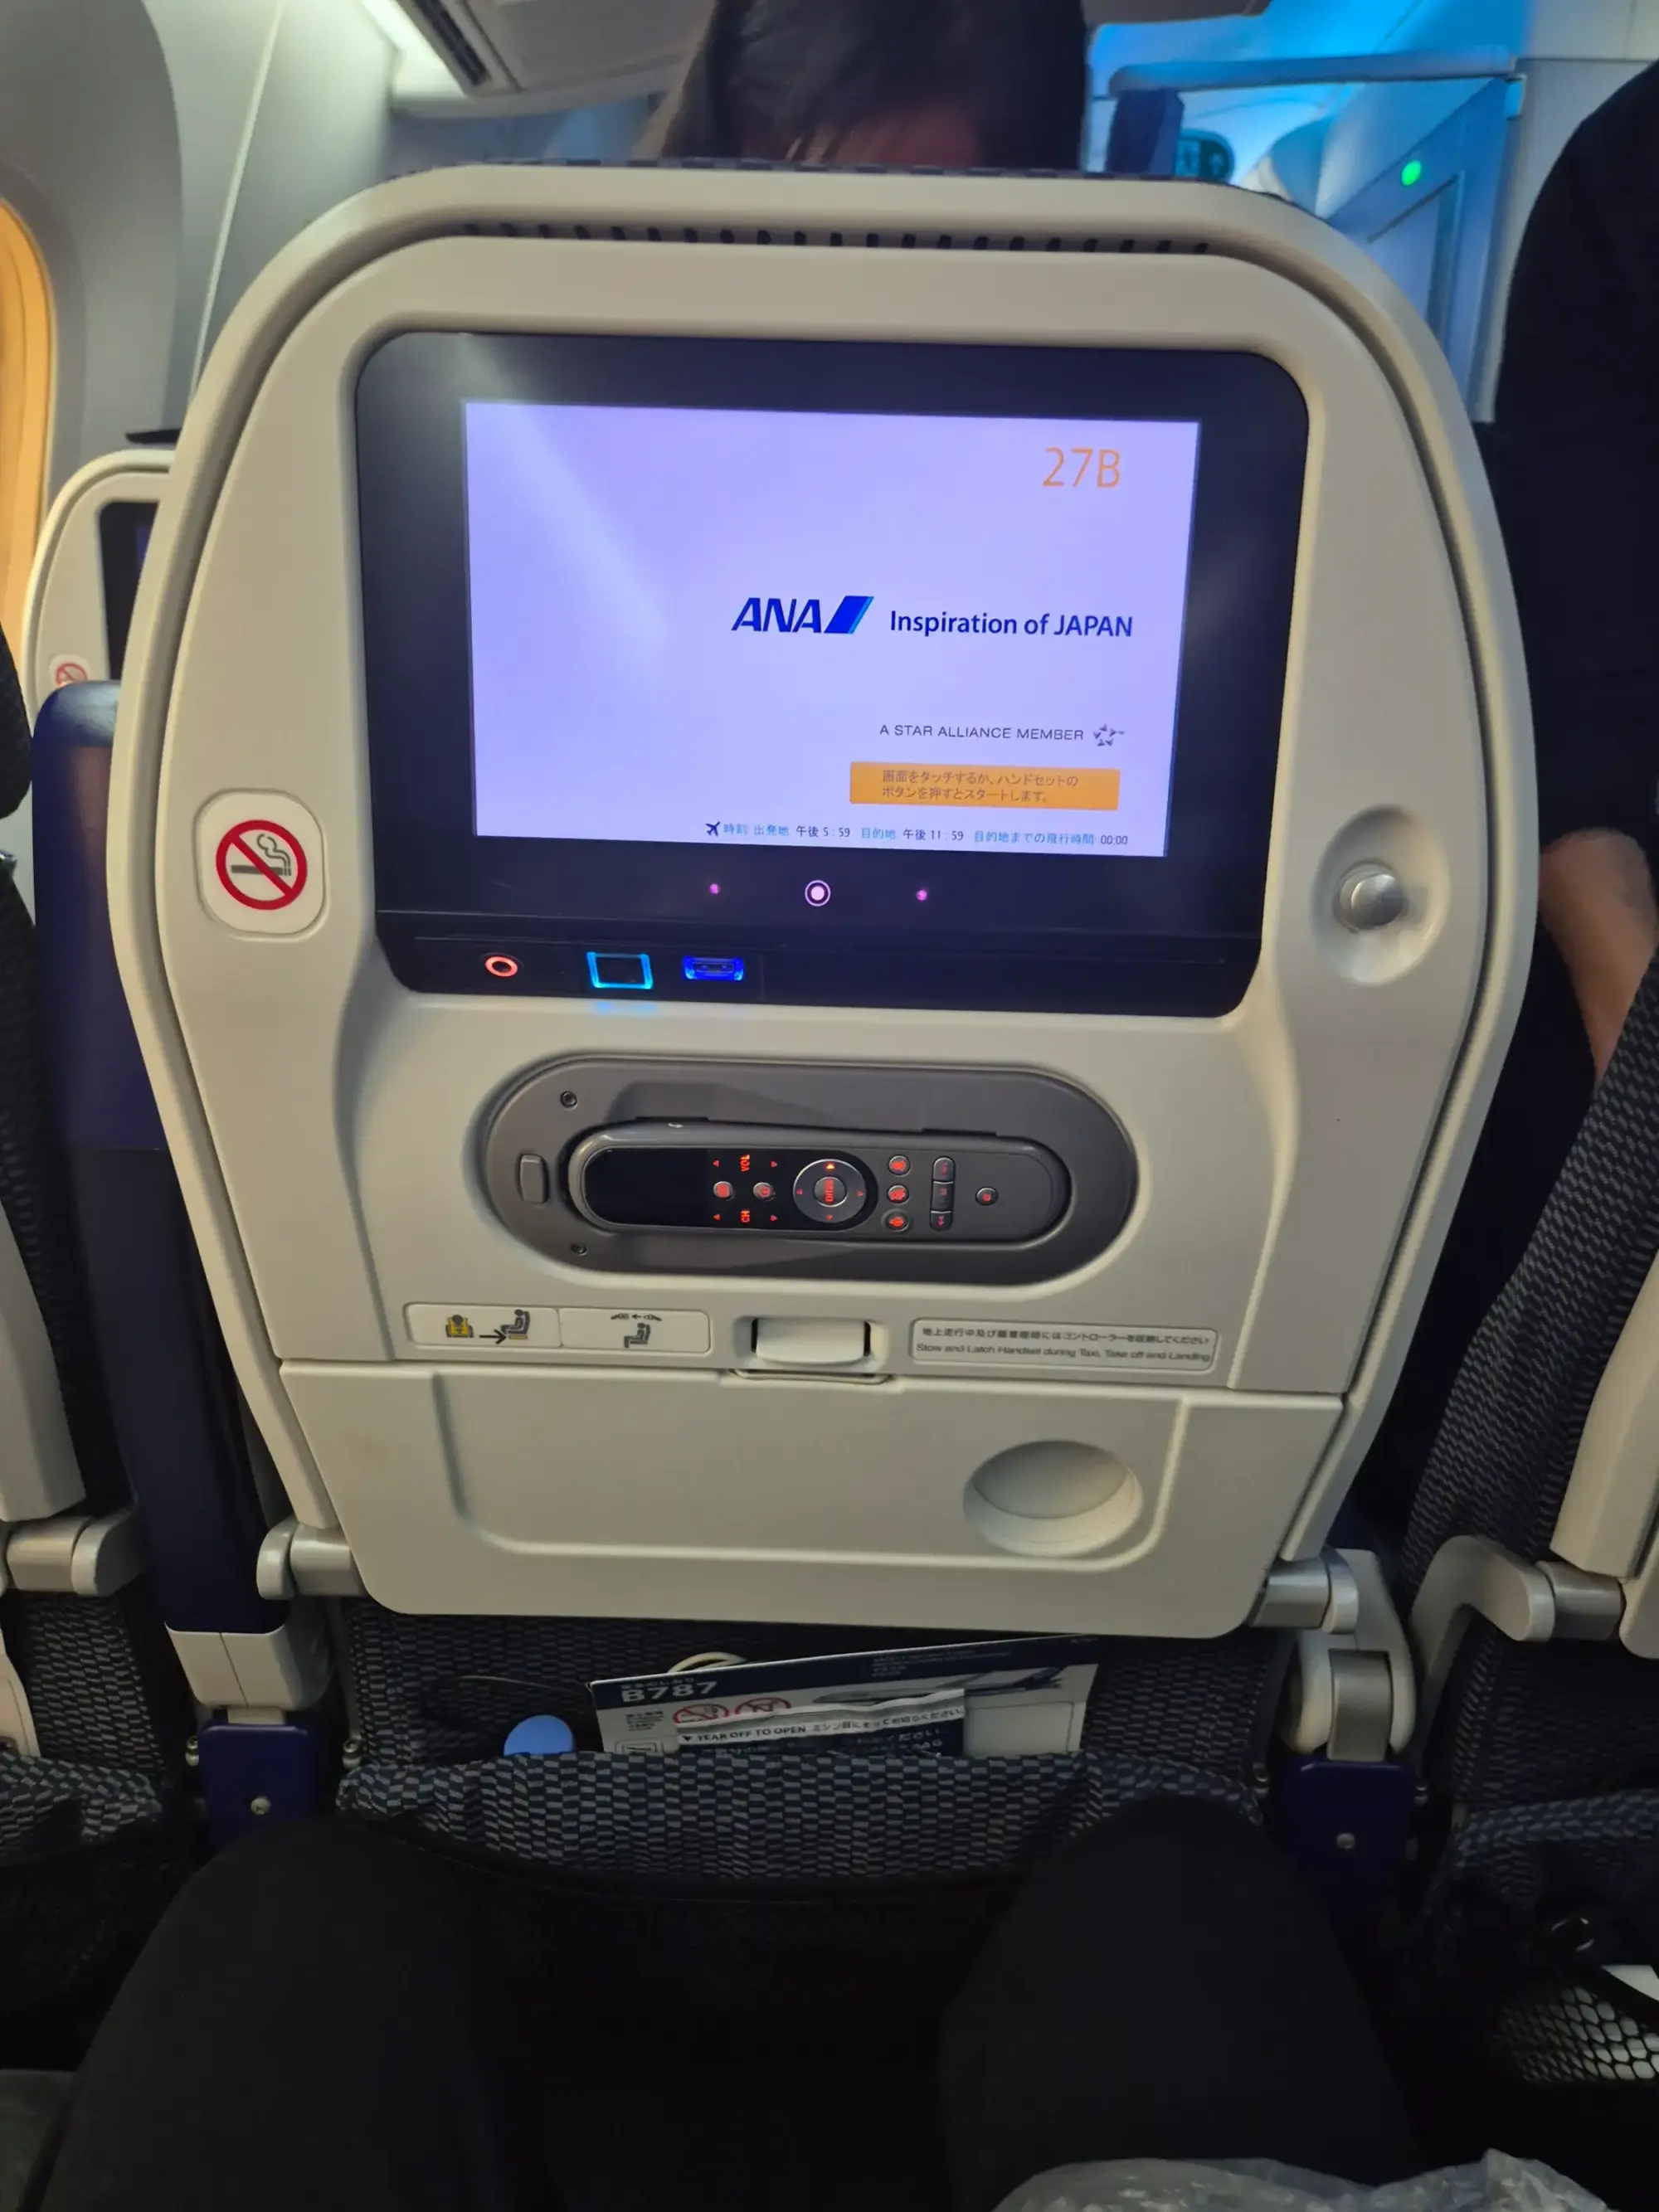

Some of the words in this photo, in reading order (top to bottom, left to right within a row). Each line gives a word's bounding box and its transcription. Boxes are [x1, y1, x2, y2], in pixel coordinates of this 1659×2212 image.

[1042, 447, 1122, 489] 27B
[731, 596, 822, 633] ANA
[890, 610, 1018, 637] Inspiration
[1024, 613, 1050, 634] of
[1053, 615, 1133, 637] JAPAN
[879, 724, 890, 736] A
[894, 725, 933, 737] STAR
[937, 726, 1012, 739] ALLIANCE
[1017, 727, 1084, 741] MEMBER
[740, 1155, 751, 1172] VOL
[741, 1209, 751, 1223] CH
[916, 1343, 942, 1353] Stow
[944, 1344, 965, 1353] and
[967, 1344, 995, 1354] Latch
[998, 1346, 1042, 1355] Handset
[1044, 1347, 1076, 1358] during
[1169, 1351, 1211, 1362] Landing
[621, 1680, 718, 1703] B787
[697, 1733, 727, 1743] TEAR
[730, 1730, 752, 1739] OFF
[755, 1728, 772, 1737] TO
[774, 1726, 806, 1736] OPEN
